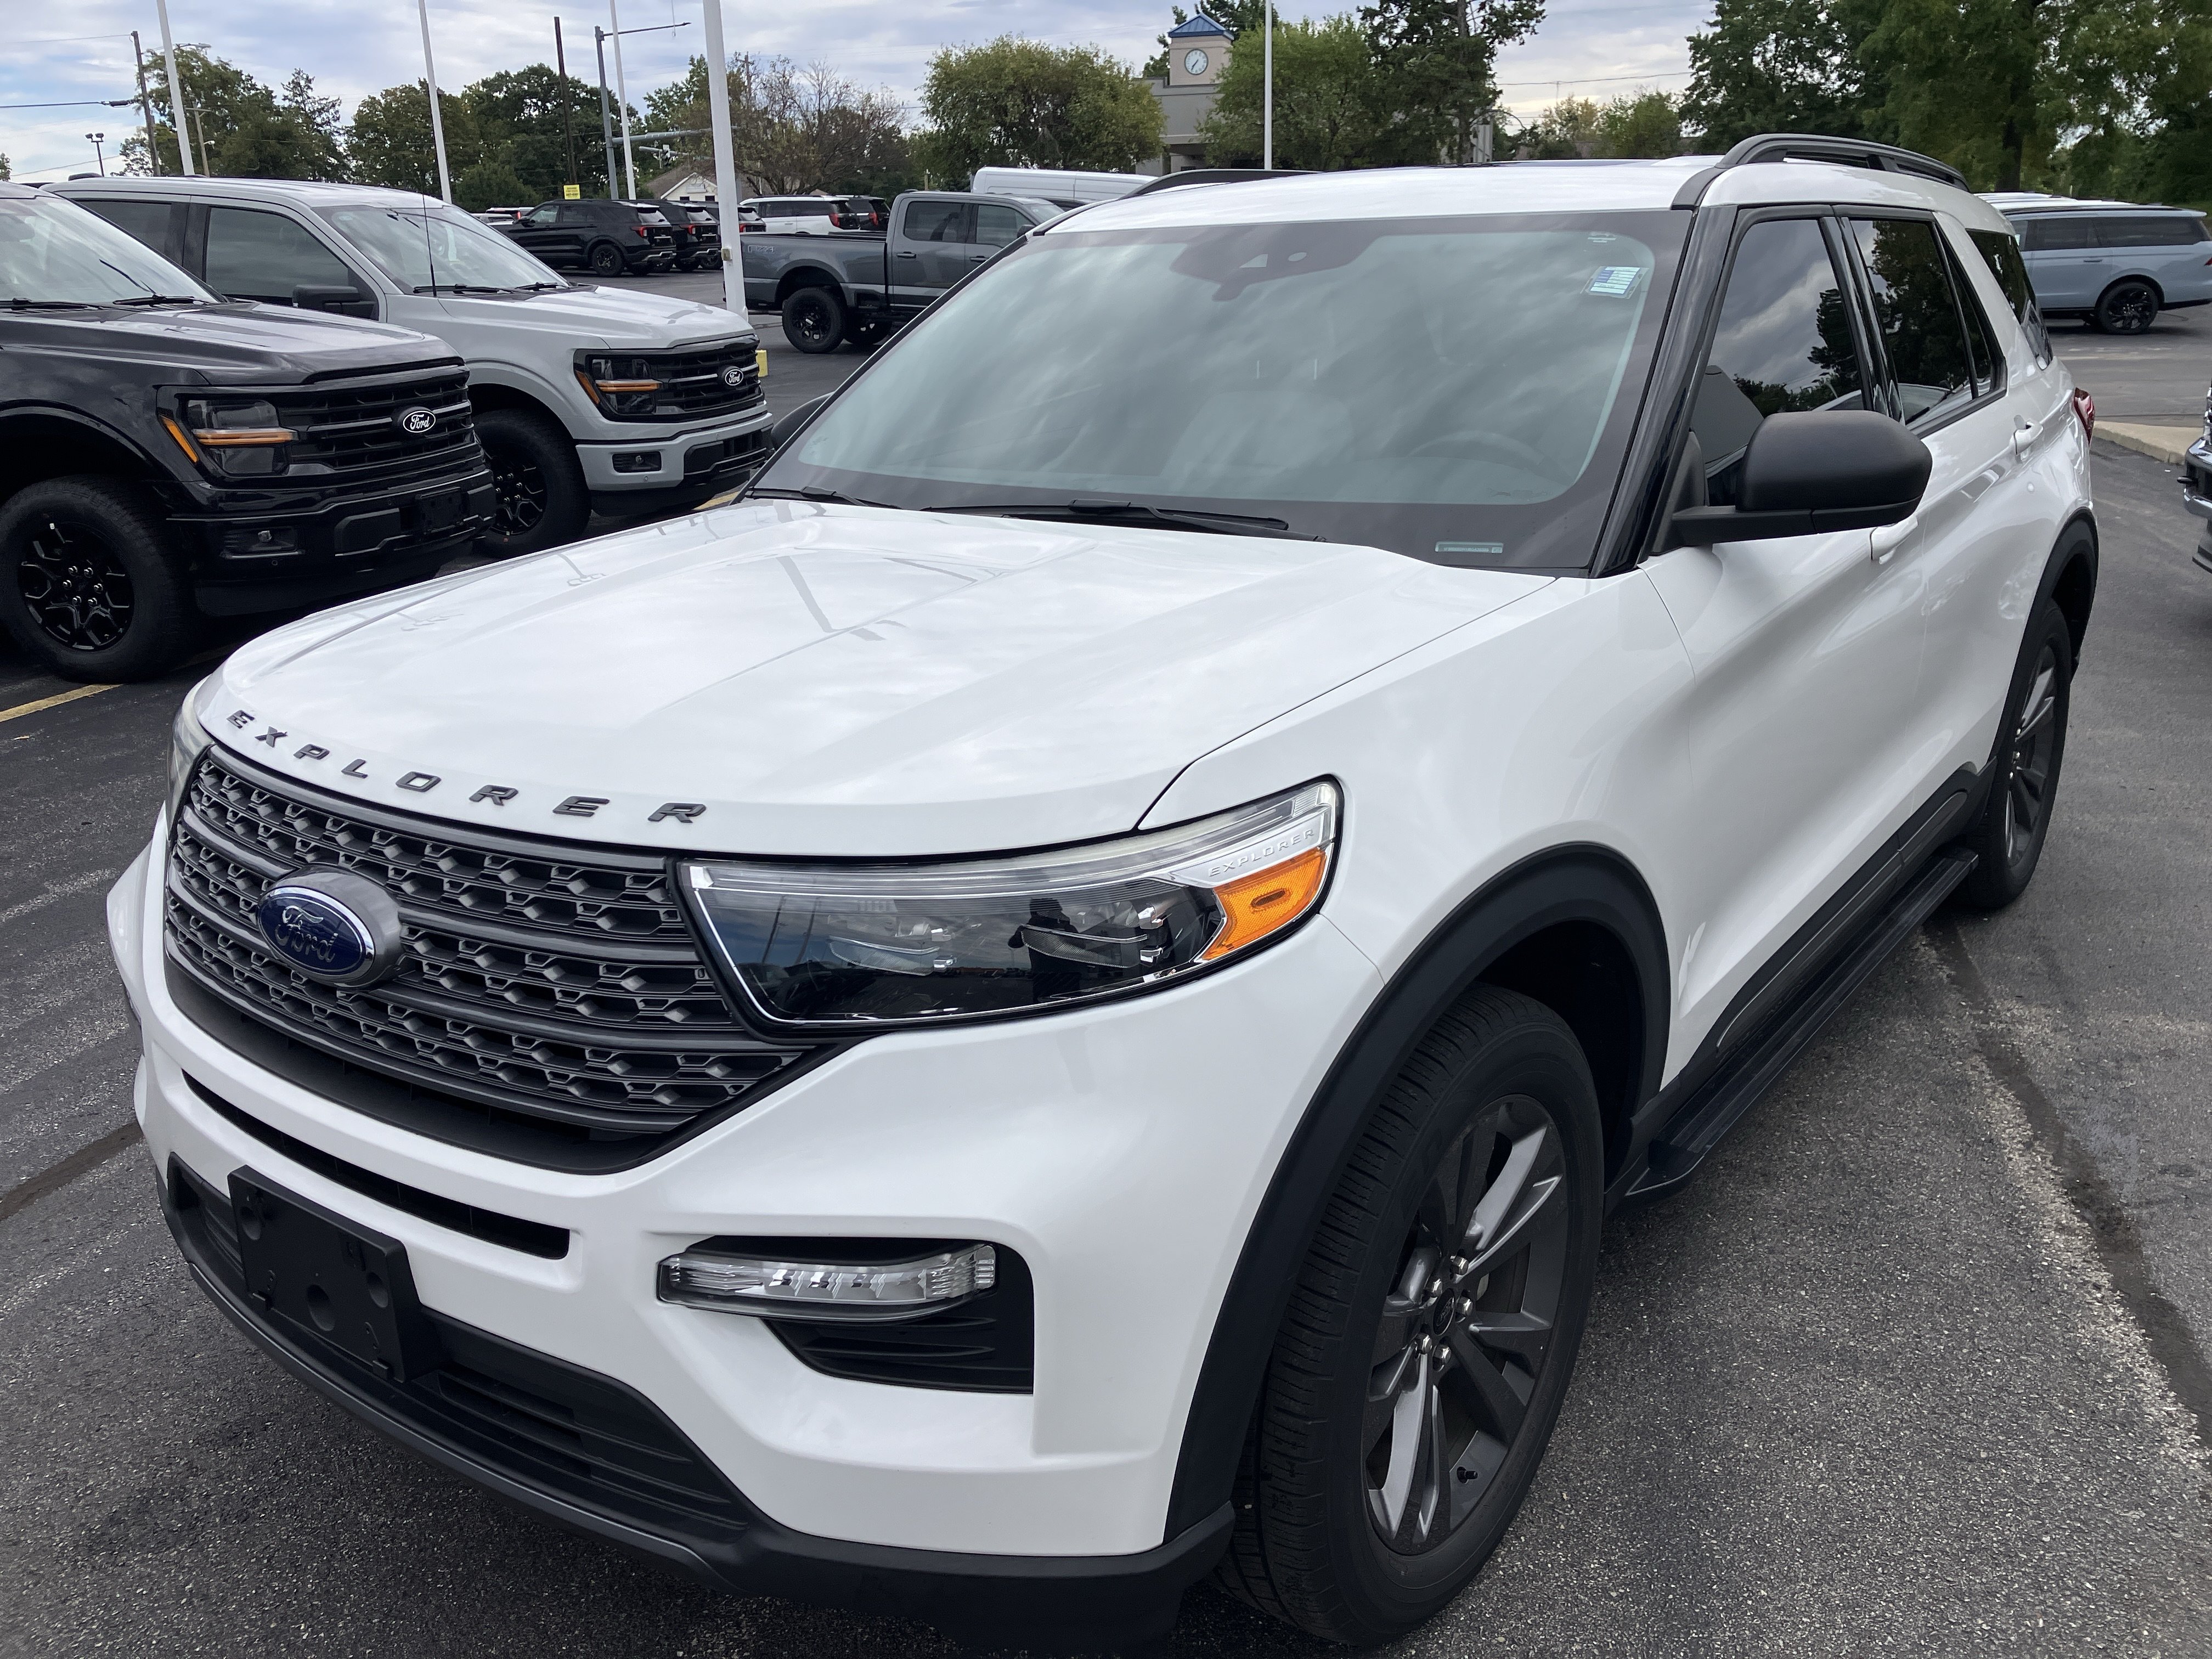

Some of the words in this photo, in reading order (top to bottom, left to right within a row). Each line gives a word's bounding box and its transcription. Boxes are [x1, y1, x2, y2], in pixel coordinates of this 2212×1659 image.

[729, 371, 741, 383] Ford
[410, 414, 430, 430] Ford
[227, 709, 707, 823] EXPLORER
[1209, 829, 1314, 877] EXPLORER
[275, 905, 338, 963] Ford
